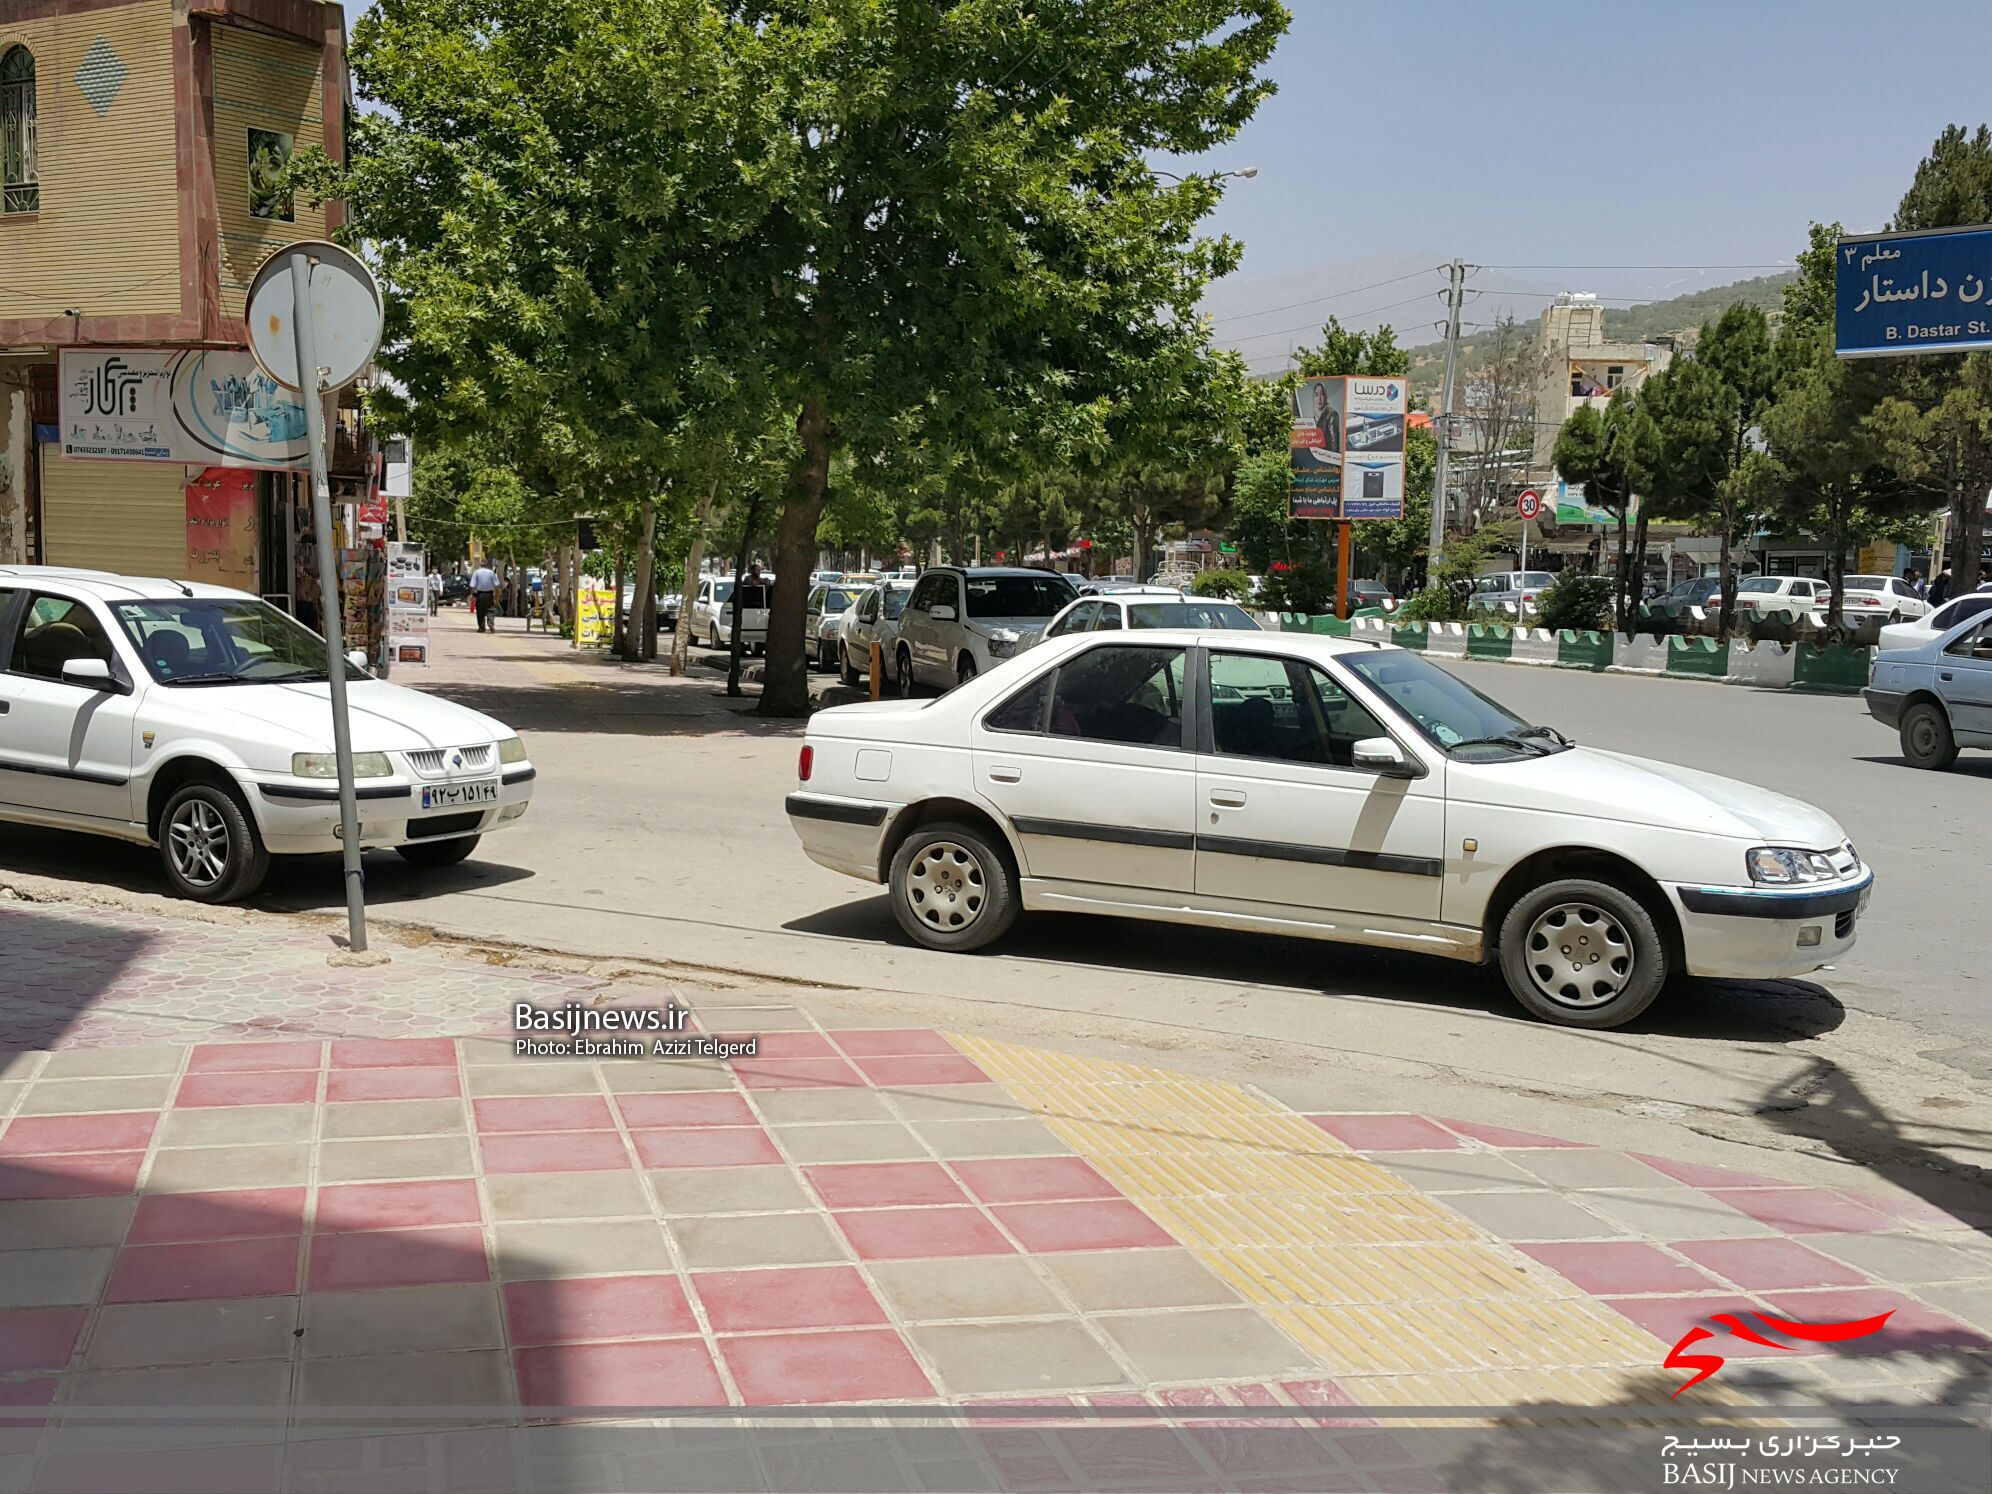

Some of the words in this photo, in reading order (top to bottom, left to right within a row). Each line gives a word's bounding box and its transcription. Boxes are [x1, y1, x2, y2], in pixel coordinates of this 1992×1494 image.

[1844, 246, 1858, 265] ۳
[1862, 244, 1901, 271] معلم
[1854, 270, 1948, 313] داستار
[1886, 327, 1902, 340] B.
[1907, 325, 1961, 339] Dastar
[1967, 321, 1991, 334] St.
[1354, 381, 1386, 396] درسا
[1523, 499, 1536, 511] 30
